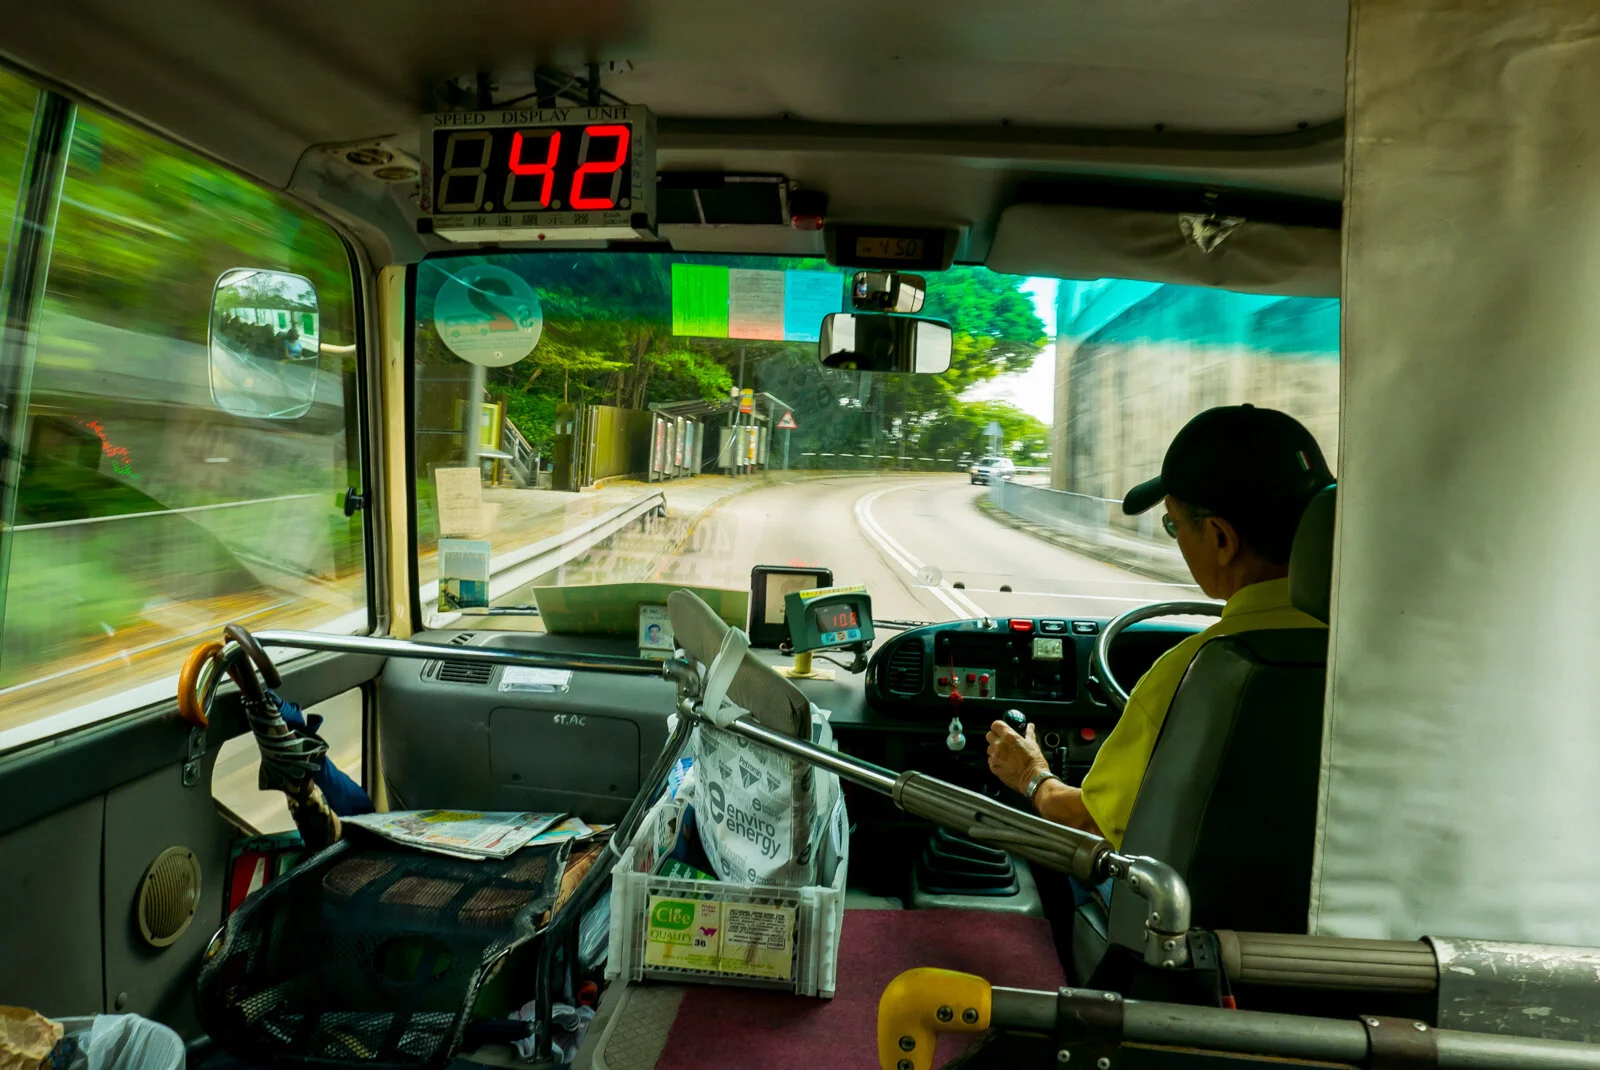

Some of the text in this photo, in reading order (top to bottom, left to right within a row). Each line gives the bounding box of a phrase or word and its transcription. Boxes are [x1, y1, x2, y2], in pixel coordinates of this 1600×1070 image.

[434, 107, 630, 126] SPEED DISPLAY UNIT
[508, 125, 630, 210] 42
[727, 804, 776, 837] enviro
[726, 818, 781, 859] energy
[650, 930, 694, 942] QUALITY
[694, 938, 707, 948] 36
